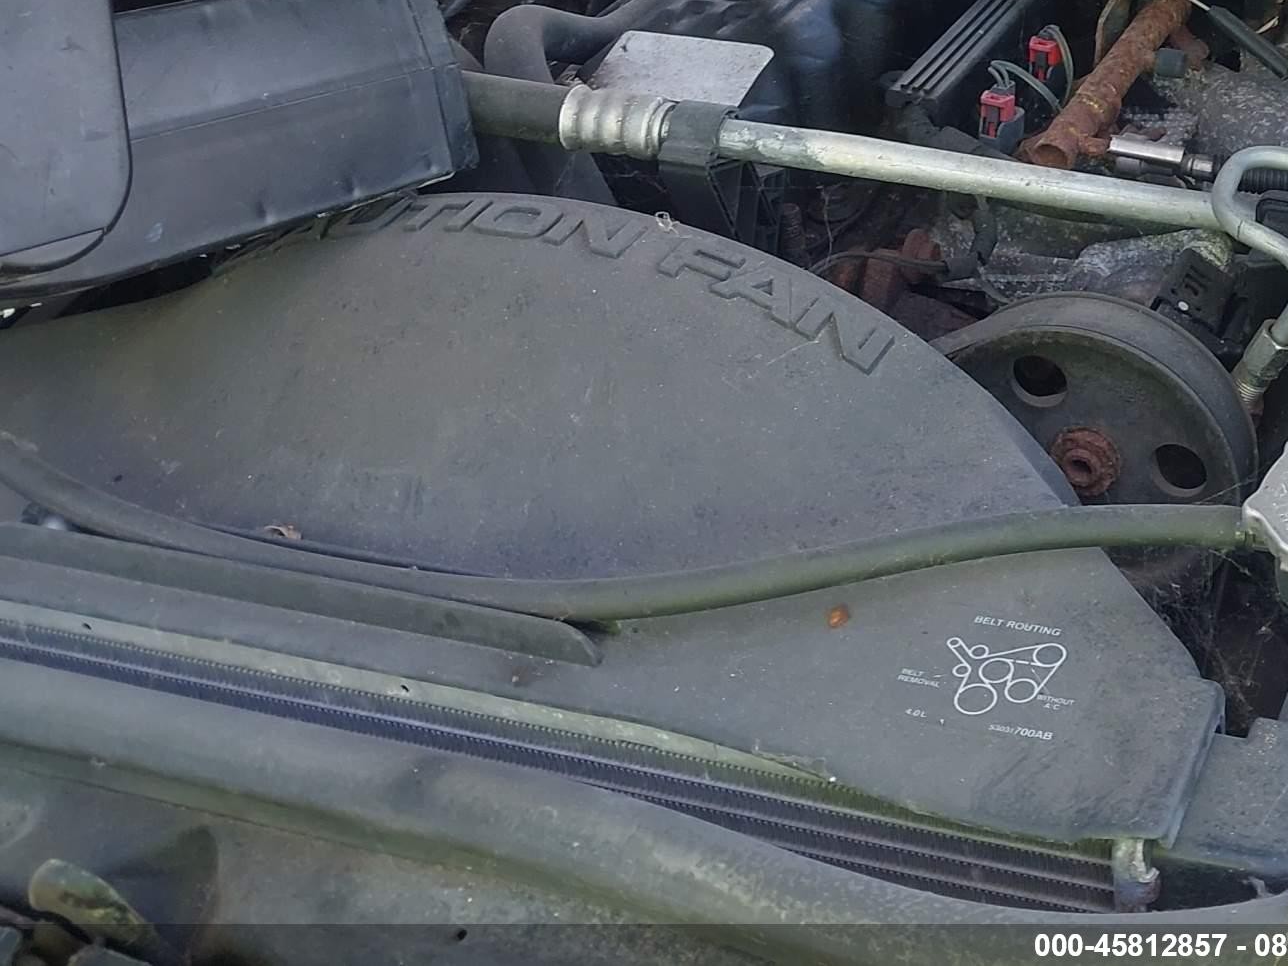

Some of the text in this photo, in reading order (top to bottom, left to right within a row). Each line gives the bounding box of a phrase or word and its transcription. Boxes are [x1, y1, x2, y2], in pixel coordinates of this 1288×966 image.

[655, 246, 897, 376] FAN
[974, 615, 1063, 638] BELT ROUTING
